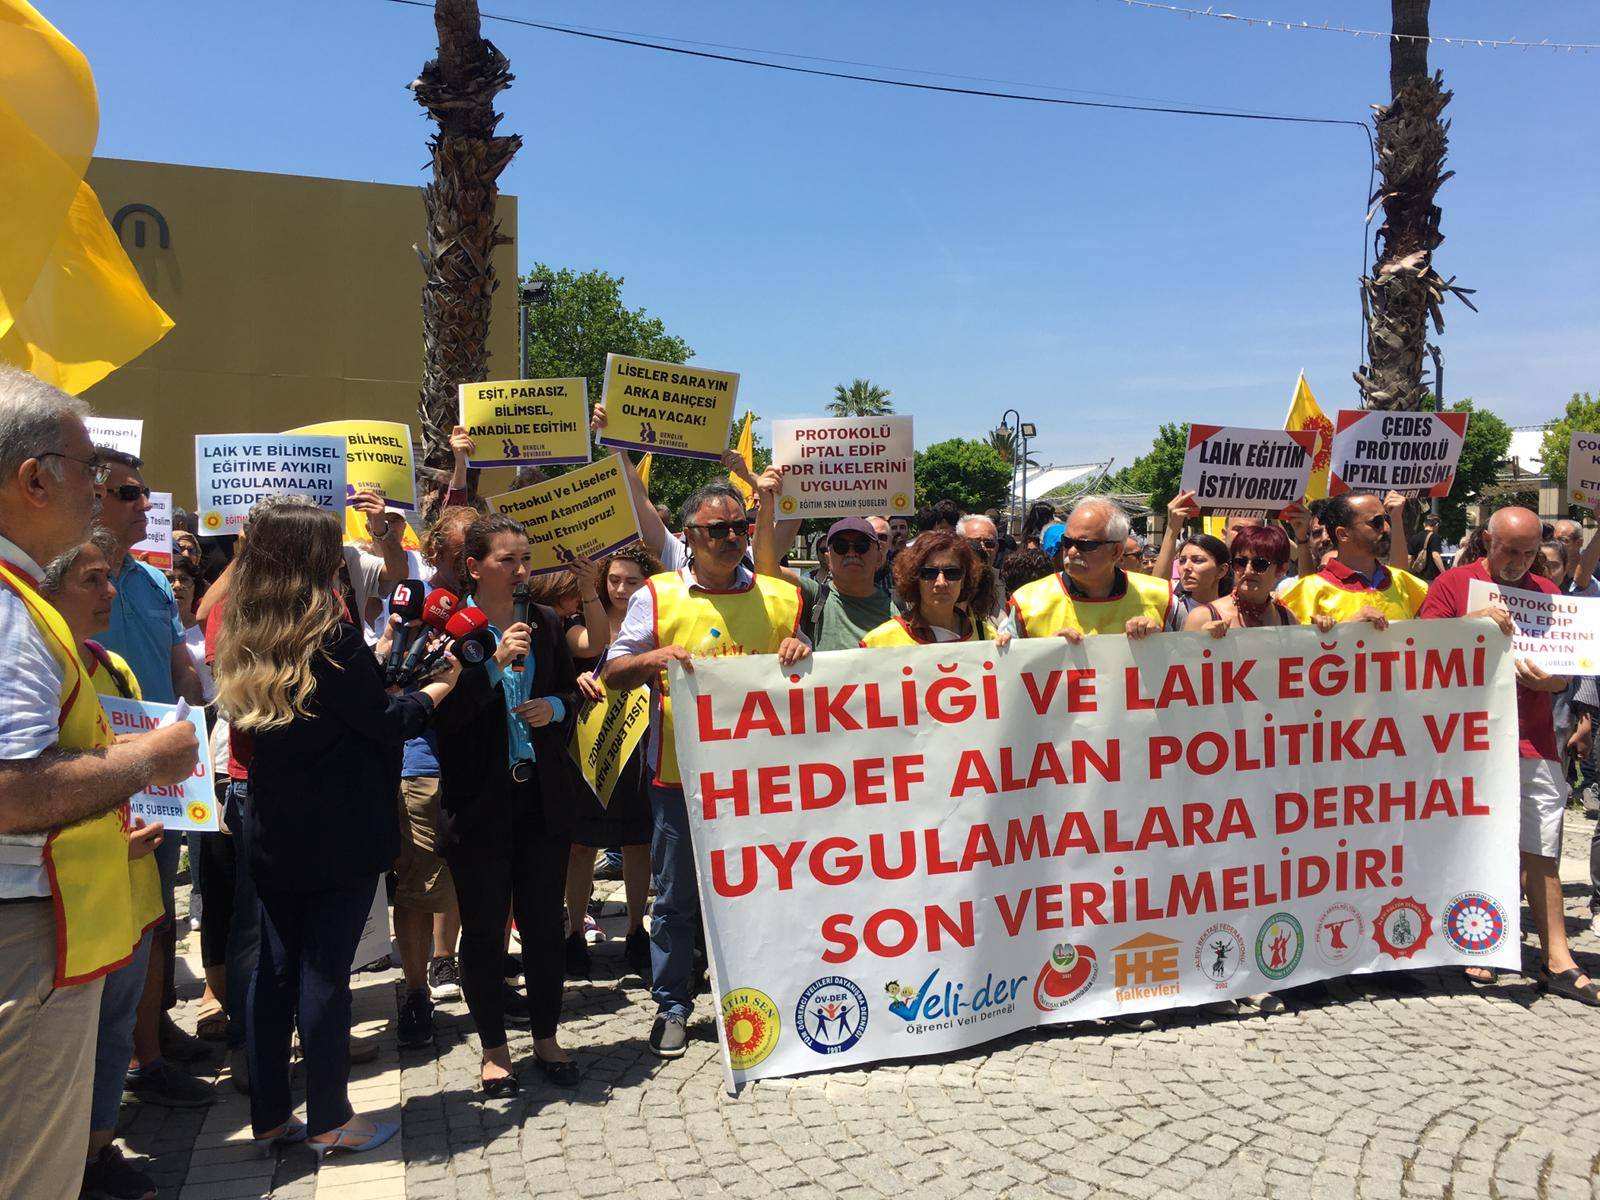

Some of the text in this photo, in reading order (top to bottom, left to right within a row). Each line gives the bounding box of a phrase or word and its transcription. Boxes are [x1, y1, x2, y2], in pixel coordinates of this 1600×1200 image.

[618, 363, 728, 392] LİSELER SARAYIN
[478, 386, 568, 401] EŞİT, PARASIZ,
[624, 385, 716, 408] ARKA BAHÇESİ
[495, 404, 553, 416] BİLİMSEL,
[622, 404, 707, 426] OLMAYACAK!
[468, 422, 530, 436] ANADİLDE
[796, 424, 890, 441] PROTOKOLÜ
[1382, 416, 1432, 438] ÇEDES
[204, 443, 340, 458] LAİK VE BİLİMSEL
[348, 433, 403, 448] BİLİMSEL
[1355, 438, 1449, 461] PROTOKOLÜ
[346, 452, 407, 466] STİYORUZ.
[801, 444, 886, 458] İPTAL EDİP
[1199, 438, 1306, 468] LAİK EĞİTİM
[213, 460, 331, 474] EĞİTİME AYKIRI
[782, 458, 907, 476] PDR İLKELERİNİ
[1342, 460, 1452, 486] İPTAL EDİLSİN!
[212, 478, 332, 490] UYGULAMALARI
[499, 468, 618, 514] Ortaokul Ve Liselere
[800, 479, 888, 492] UYGULAYIN
[1198, 470, 1298, 501] İSTİYORUZ!
[520, 488, 616, 528] mam Atamalarını
[800, 496, 888, 509] EĞİTİM SEN İZMİR ŞUBELERİ
[1212, 508, 1268, 519] HALKEVLERİ
[528, 506, 616, 546] abul Etmiyoruz!
[1489, 592, 1578, 614] PROTOKOLÜ
[1500, 608, 1573, 626] TAL EDİP
[1513, 628, 1594, 640] LKELERİNİ
[1513, 641, 1574, 653] GULAYIN
[696, 634, 1486, 742] LAİKLİĞİ VE LAİK EĞİTİMİ
[112, 710, 160, 730] BİLİM
[608, 694, 648, 761] LİSELERDE
[700, 708, 1491, 820] HEDEF ALAN POLİTİKA VE
[130, 801, 183, 817] MİR ŞUBELERİ
[710, 776, 1490, 898] UYGULAMALARA DERHAL
[820, 838, 1404, 964] SON VERİLMELİDİR!
[803, 977, 832, 996] VELİLERİ
[834, 977, 865, 1005] DAYANIŞMA
[1116, 982, 1180, 1002] halkevleri
[752, 998, 774, 1018] SEN
[815, 994, 848, 1004] ÖV-DER
[796, 995, 806, 1030] ÖĞRENCİ
[854, 1005, 867, 1040] DERNEĞİ
[906, 1004, 1016, 1034] Öğrenci Veli Derneği
[800, 1030, 814, 1046] TÜM
